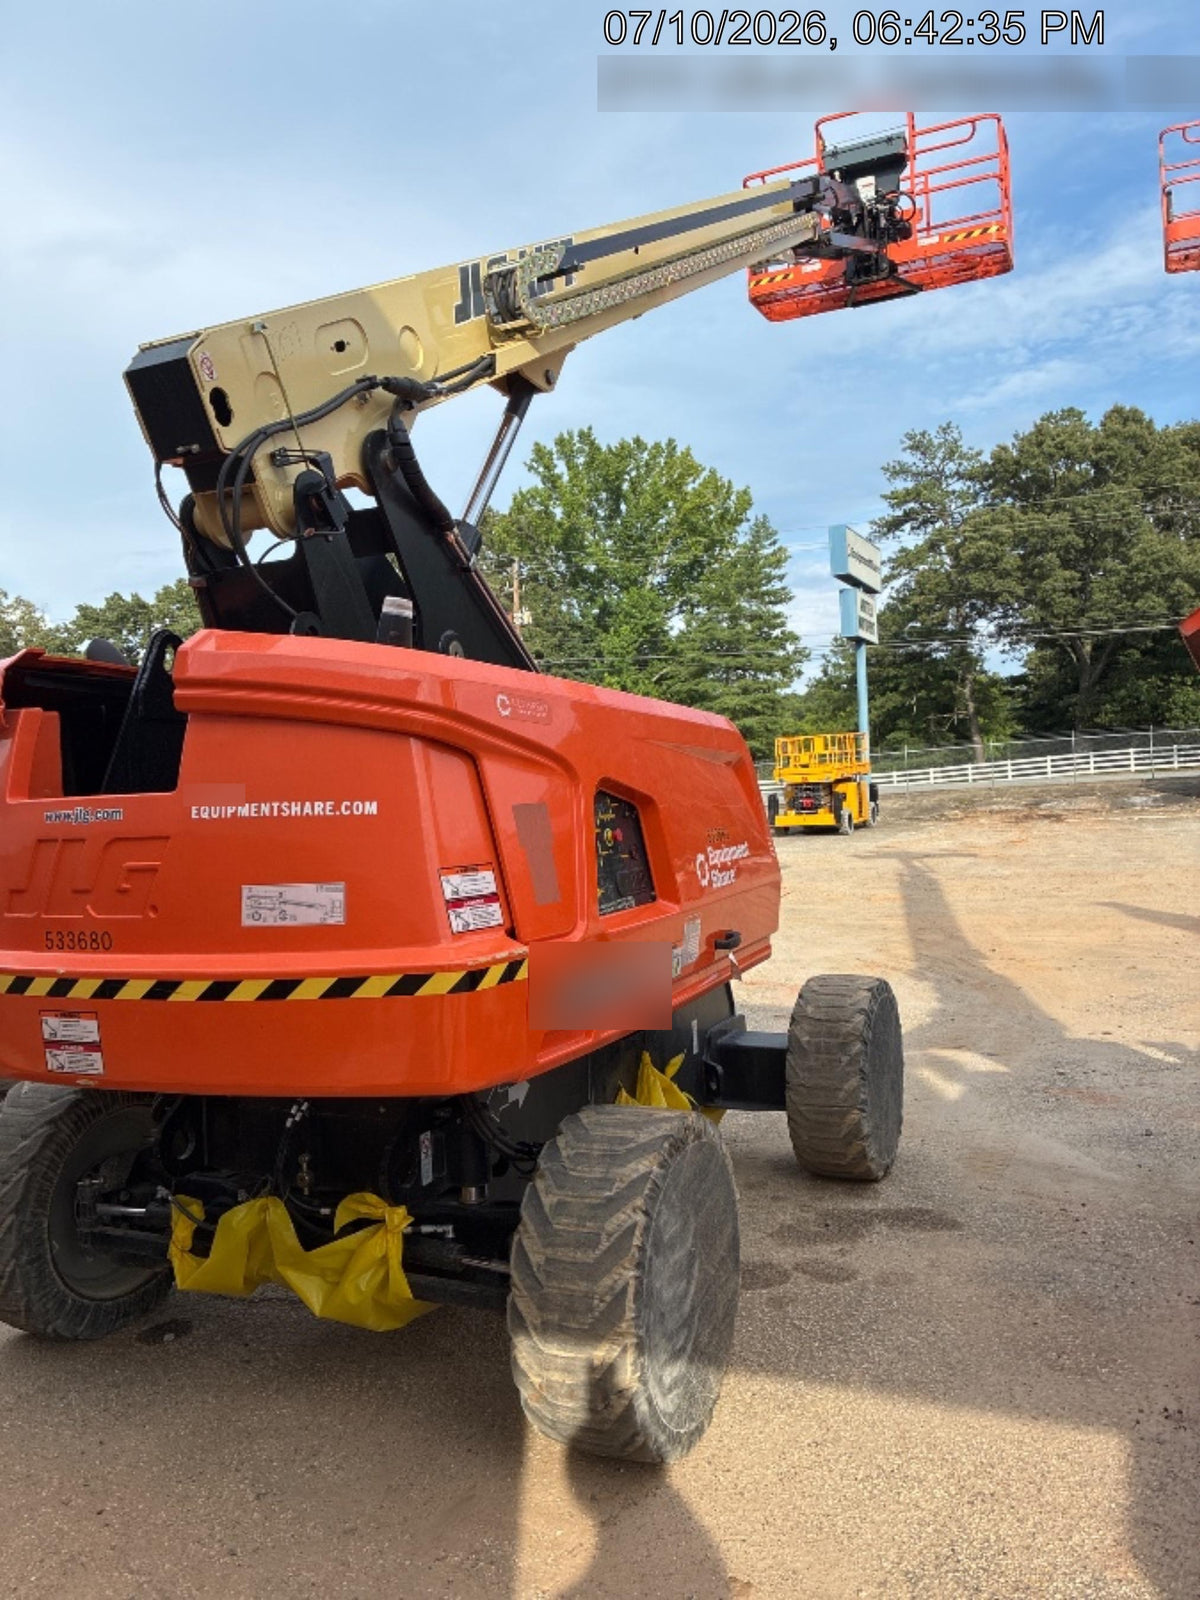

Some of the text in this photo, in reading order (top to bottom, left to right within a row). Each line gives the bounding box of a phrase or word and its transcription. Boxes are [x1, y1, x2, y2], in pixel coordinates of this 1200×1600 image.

[44, 807, 124, 825] www.jlg.com
[190, 801, 378, 820] EQUIPMENTSHARE.COM
[45, 931, 113, 951] 533680
